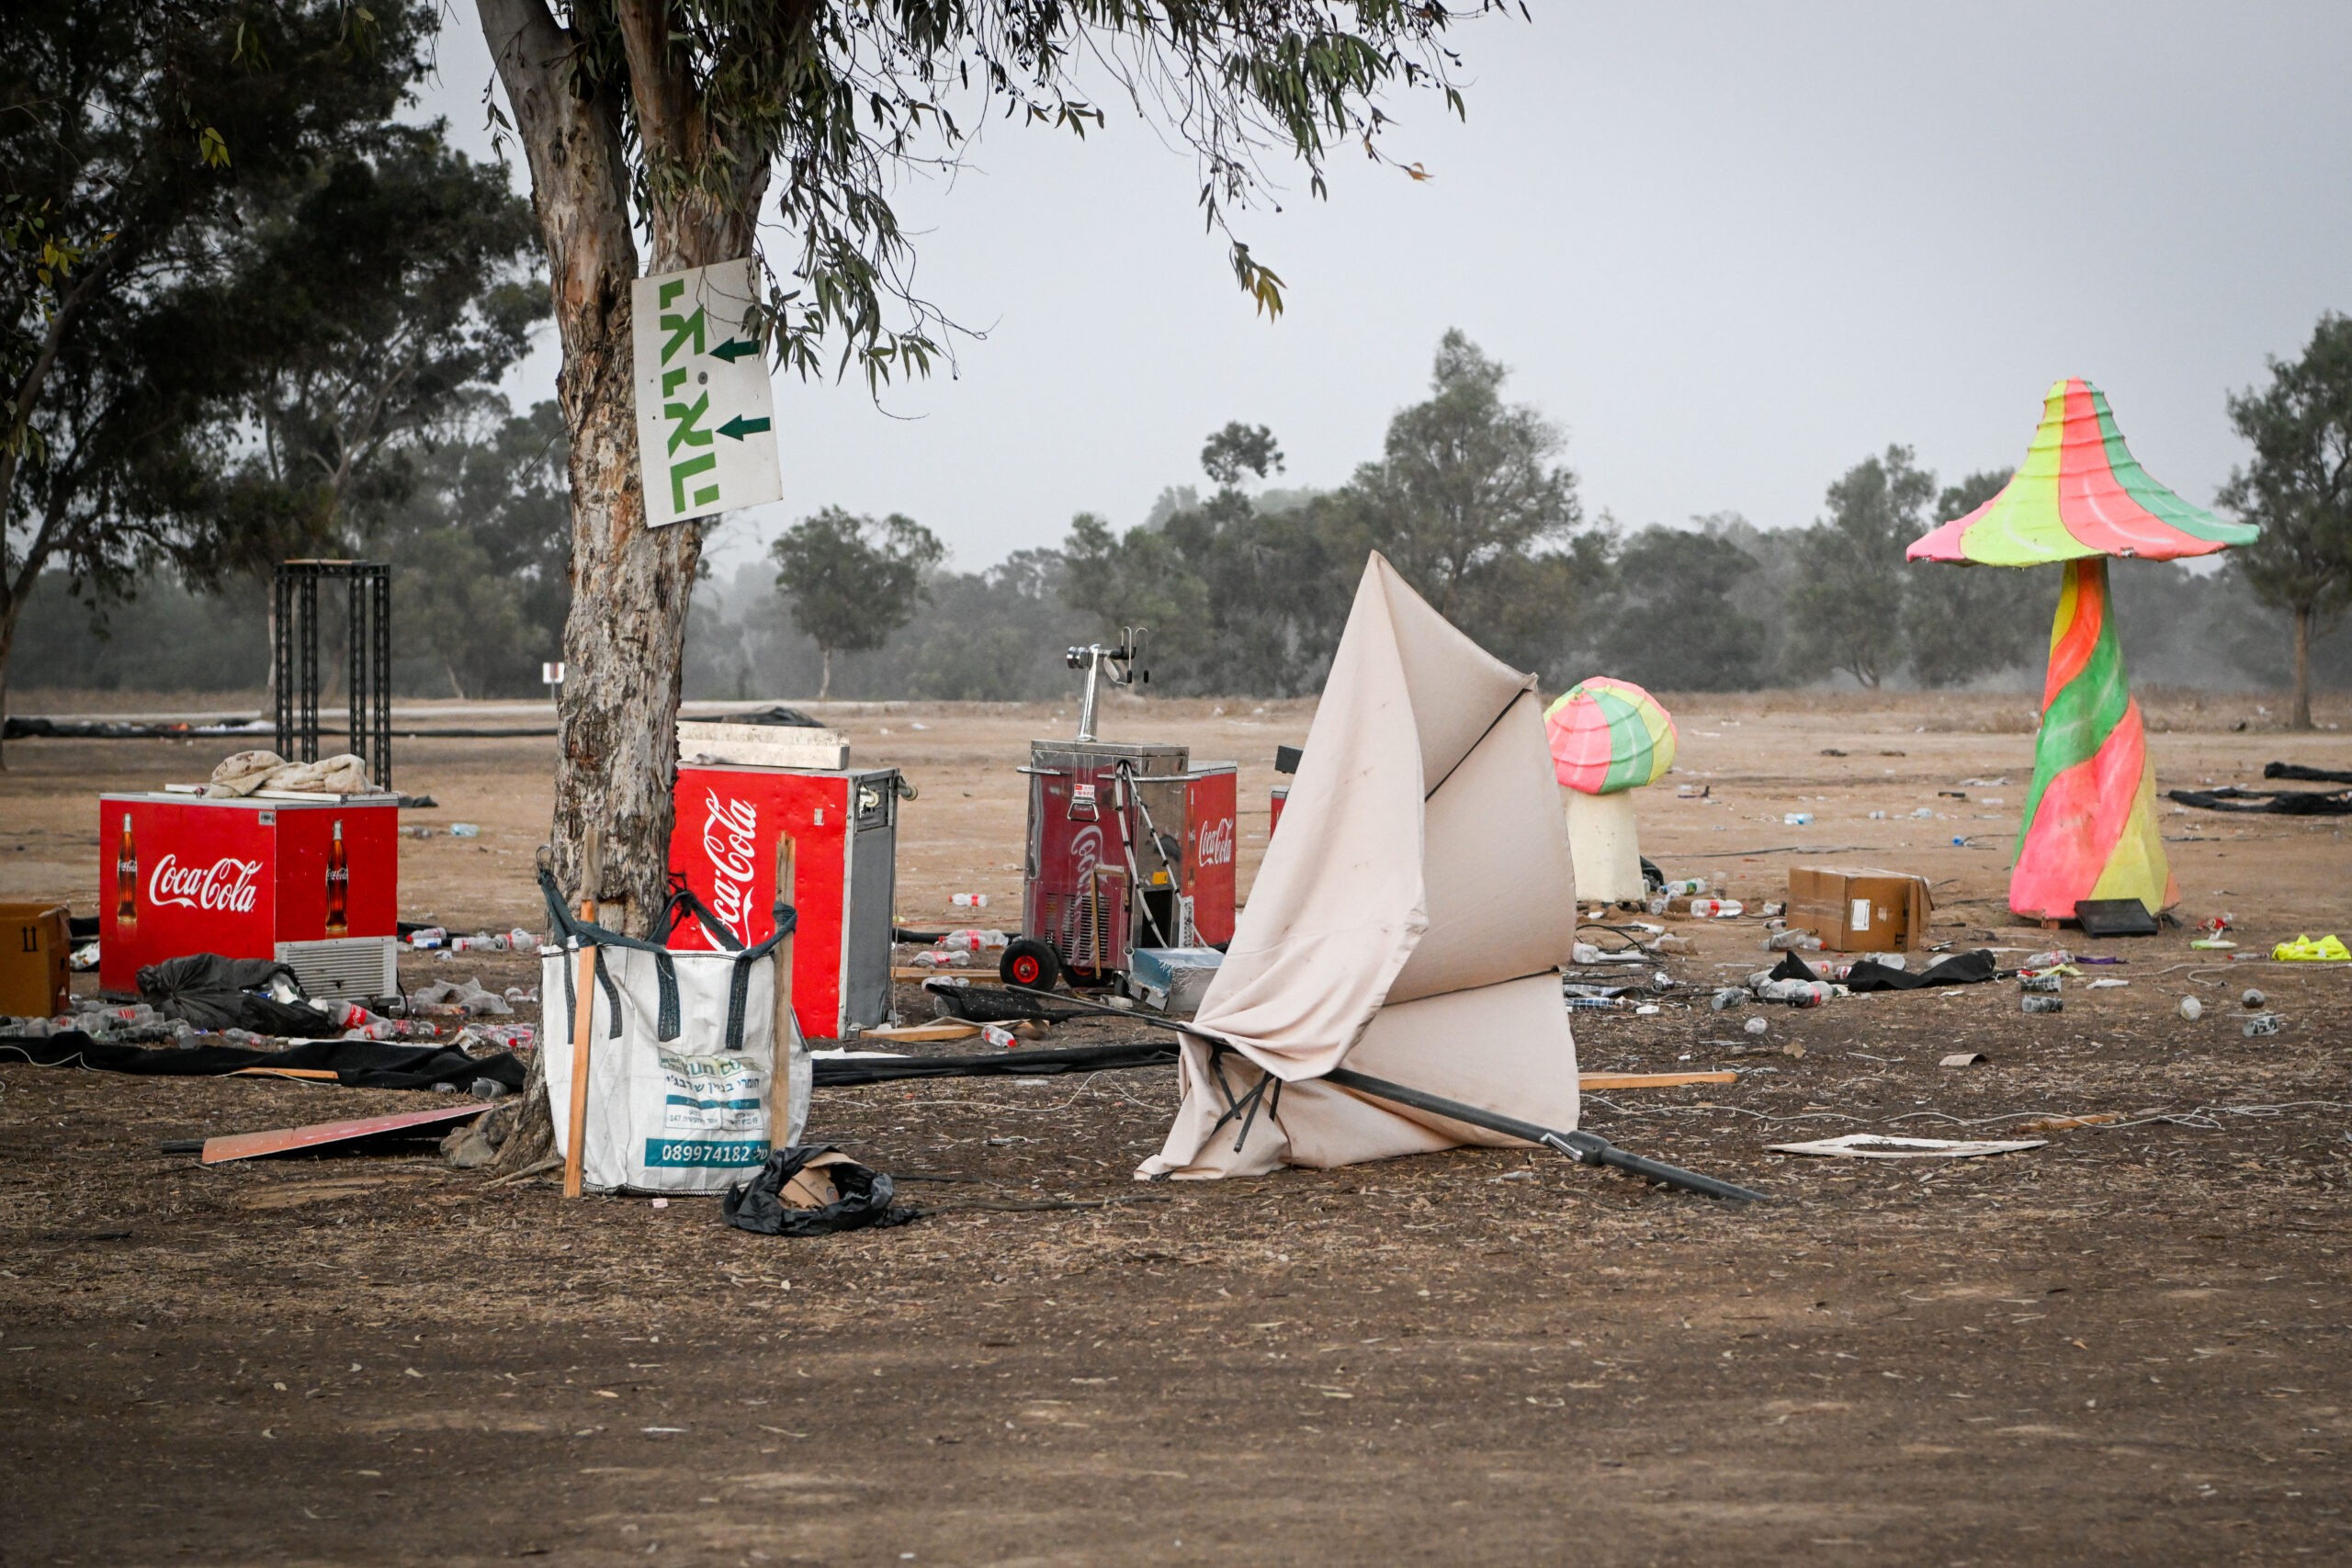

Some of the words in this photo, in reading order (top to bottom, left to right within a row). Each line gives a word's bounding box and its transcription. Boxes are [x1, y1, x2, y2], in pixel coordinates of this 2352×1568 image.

[660, 278, 719, 514] יציאה
[149, 853, 263, 912] Coca-Cola
[708, 1082, 734, 1094] בניין
[737, 1077, 760, 1089] חומרי
[662, 1145, 750, 1163] 089974182
